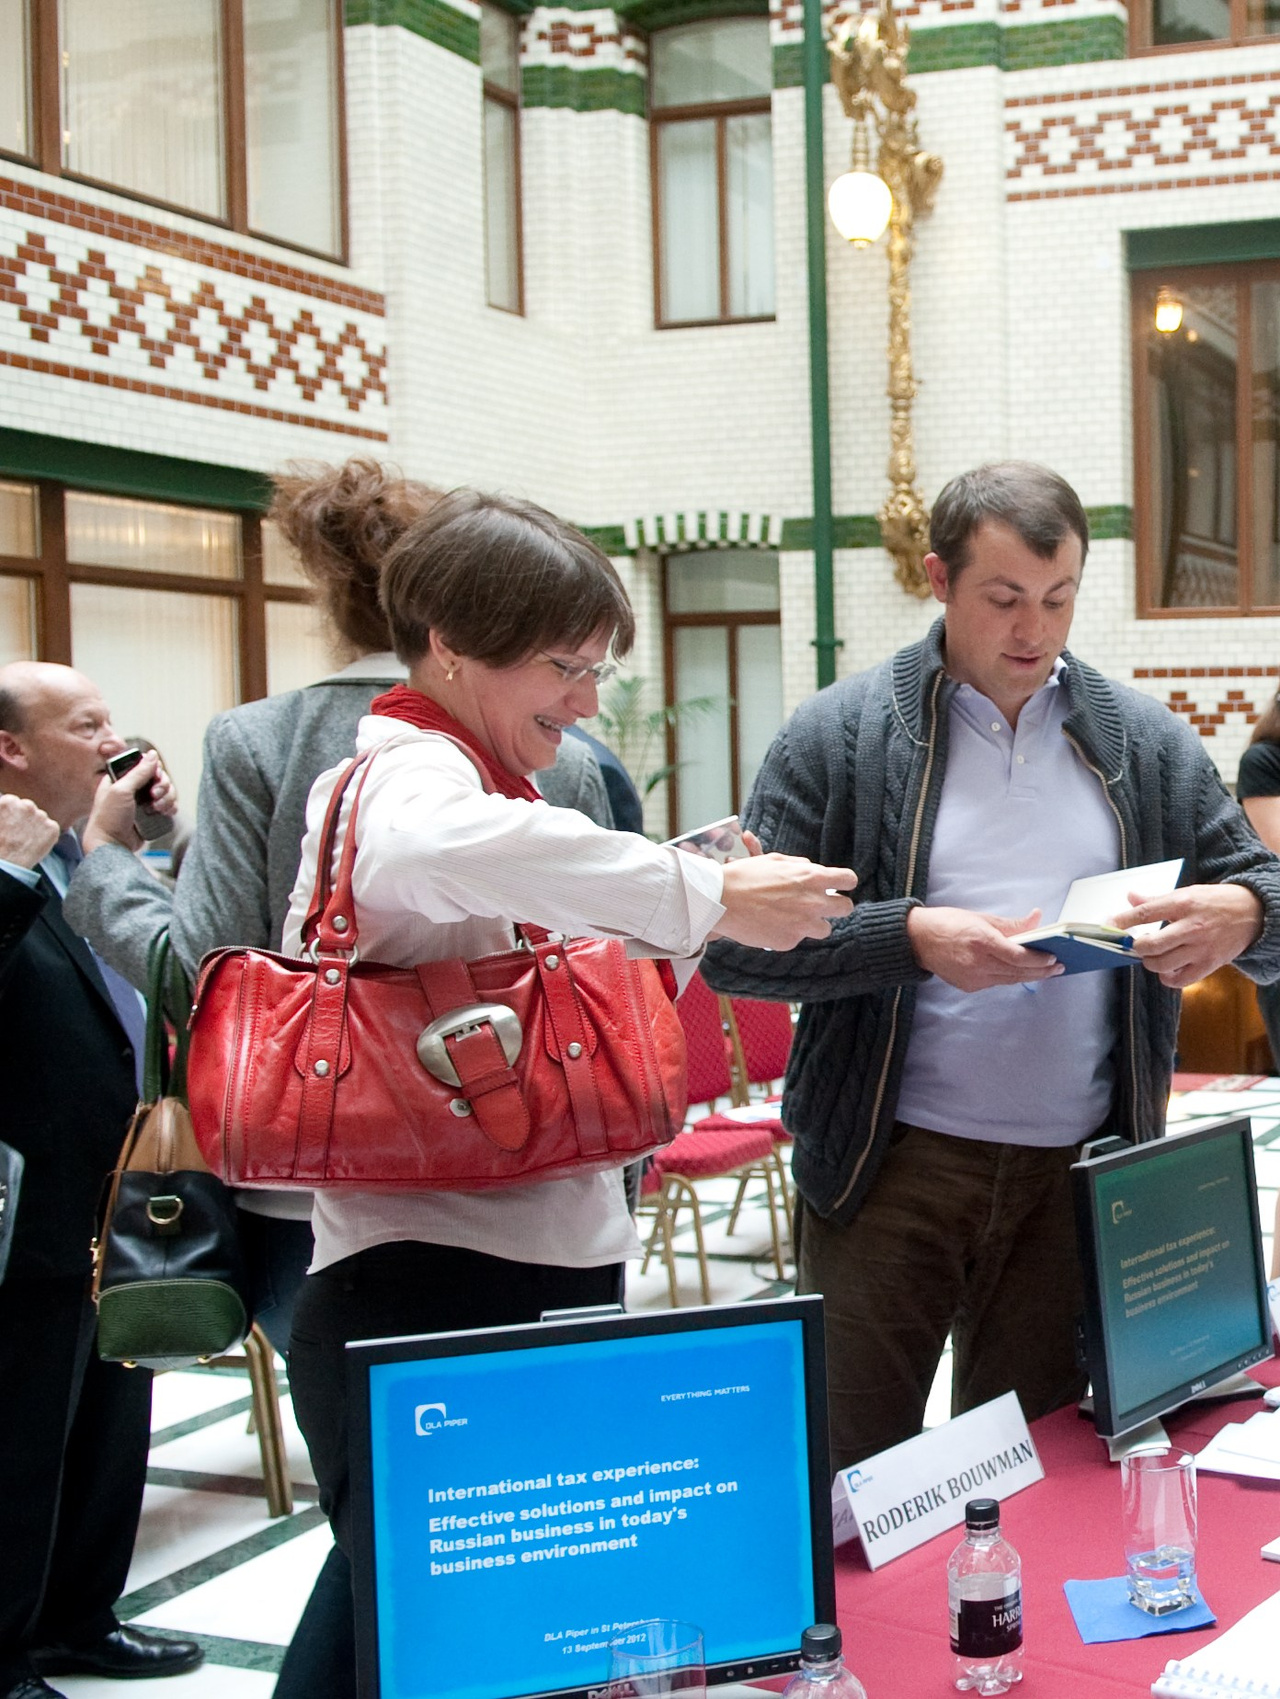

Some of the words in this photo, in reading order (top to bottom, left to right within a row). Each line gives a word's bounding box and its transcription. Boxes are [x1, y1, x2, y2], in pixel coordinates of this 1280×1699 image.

[660, 1389, 712, 1402] EVERYTHING
[714, 1385, 750, 1396] MATTERS
[426, 1421, 442, 1430] DLA
[444, 1418, 468, 1427] PIPER
[428, 1474, 552, 1504] International
[556, 1472, 588, 1486] tax
[592, 1457, 700, 1484] experience:
[862, 1484, 946, 1544] RODERIK
[946, 1440, 1034, 1500] BOUWMAN
[428, 1508, 515, 1533] Effective
[520, 1498, 606, 1522] solutions
[610, 1490, 644, 1509] and
[649, 1482, 712, 1507] impact
[716, 1479, 738, 1494] on
[429, 1533, 506, 1554] Russian
[510, 1520, 594, 1544] business
[599, 1516, 616, 1530] in
[621, 1506, 688, 1529] today's
[430, 1552, 516, 1576] business
[520, 1534, 638, 1564] environment
[544, 1632, 563, 1642] DLA
[565, 1628, 589, 1639] Piper
[590, 1626, 599, 1634] in
[601, 1624, 611, 1633] St
[562, 1645, 573, 1654] 13
[626, 1633, 647, 1644] 2012
